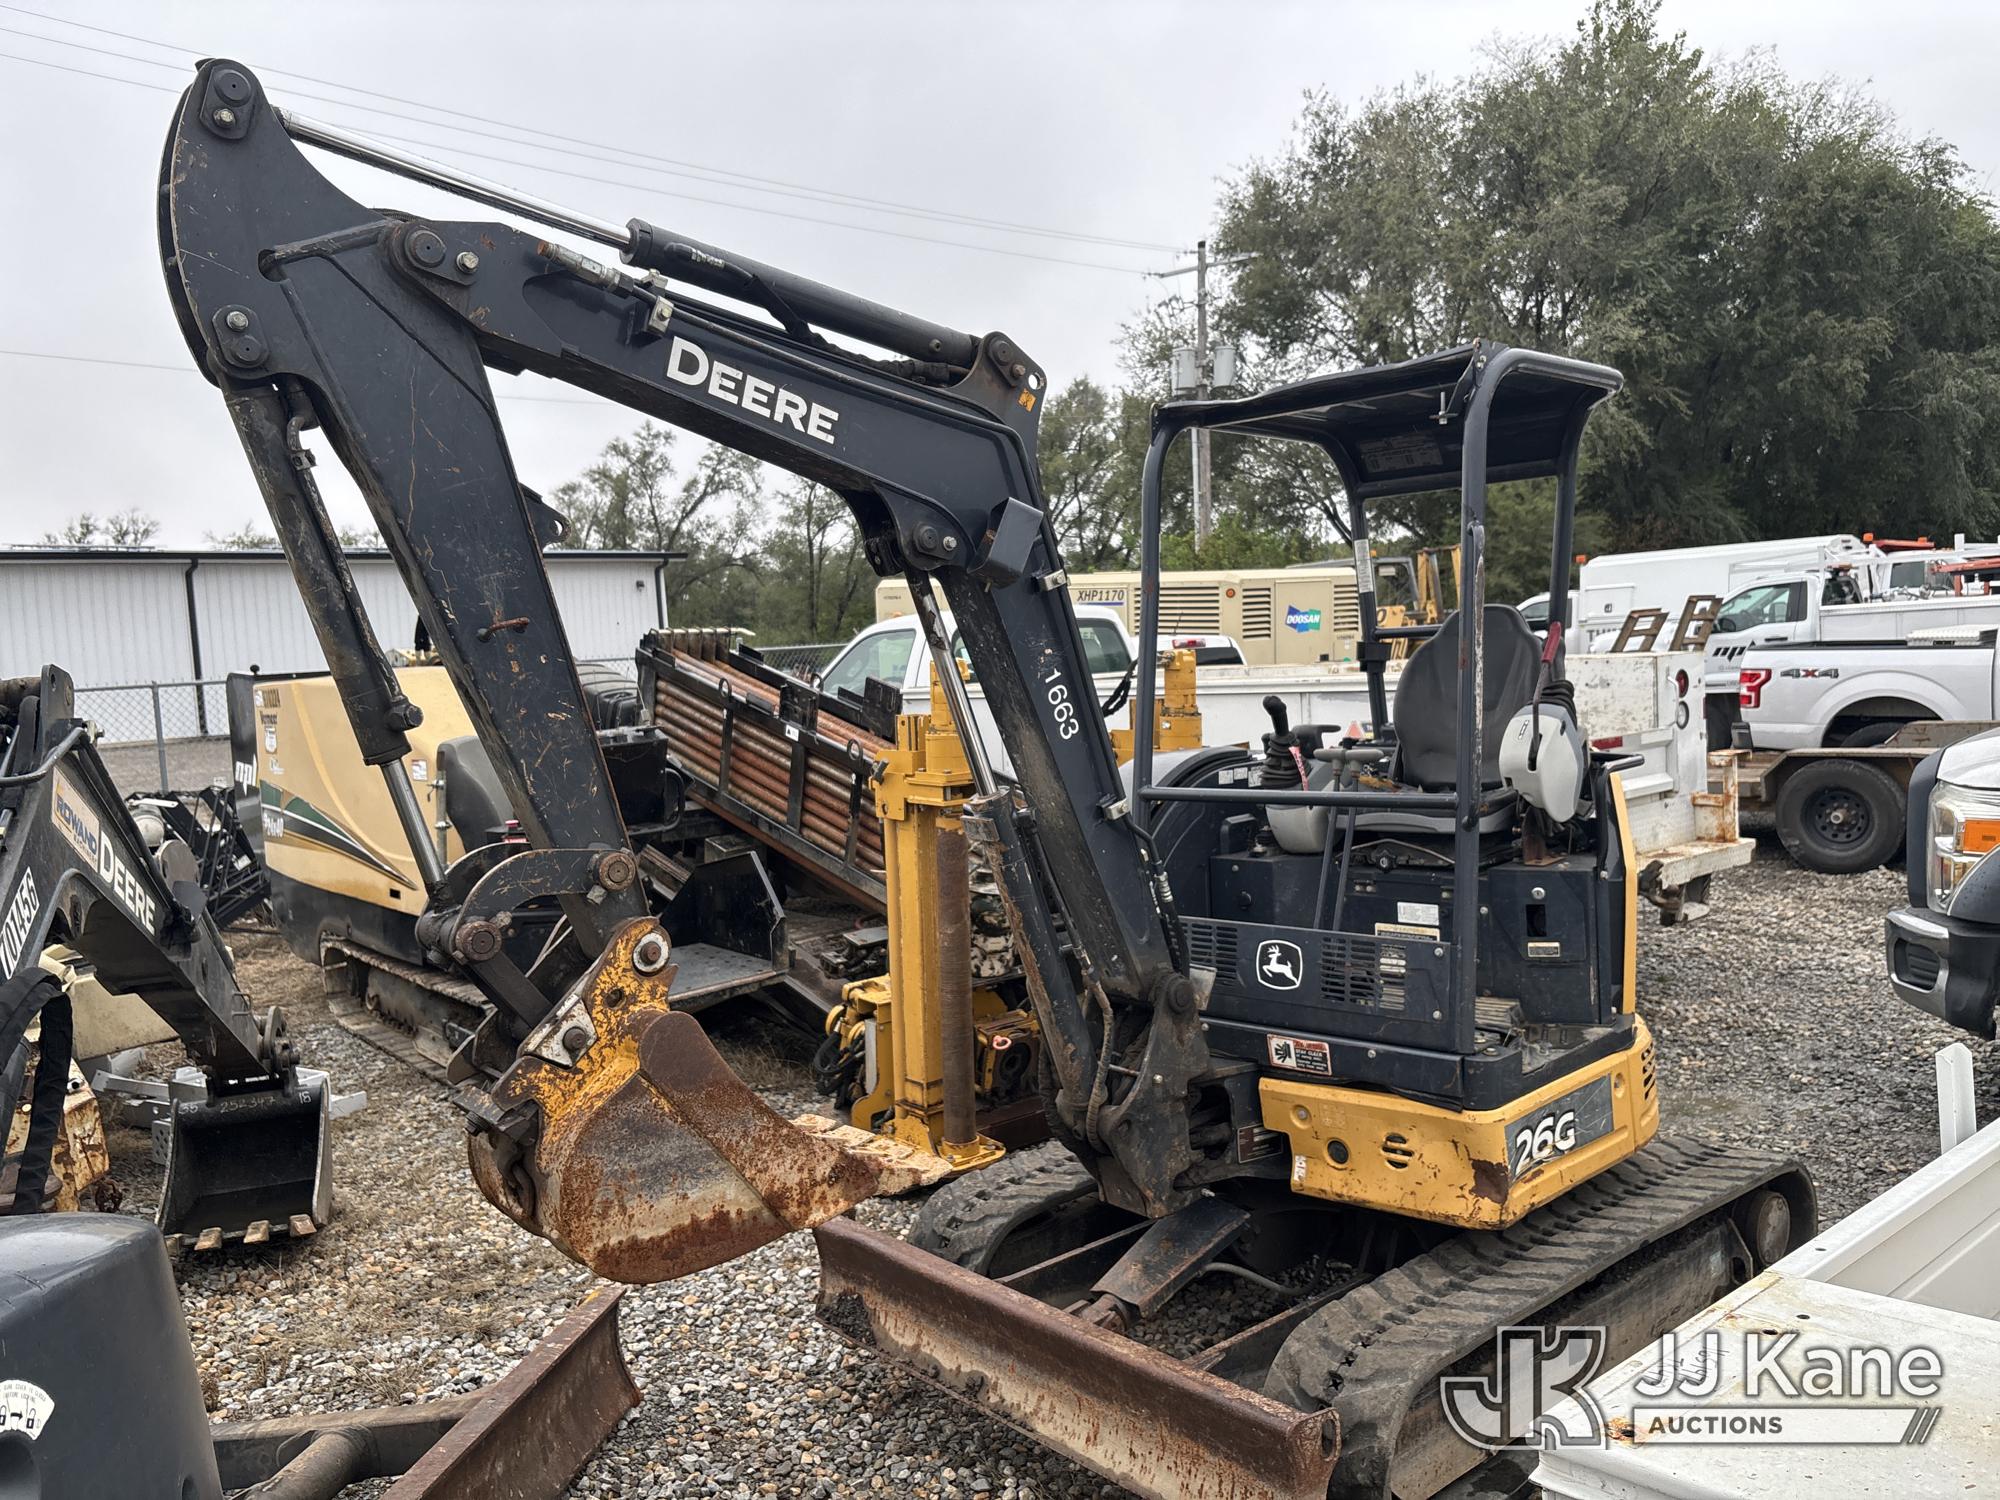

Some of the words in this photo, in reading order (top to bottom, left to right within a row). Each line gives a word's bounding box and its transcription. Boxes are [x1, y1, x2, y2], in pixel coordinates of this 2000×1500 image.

[667, 336, 839, 444] DEERE
[1077, 590, 1125, 602] XHP1170
[1286, 614, 1320, 625] DOOSAN
[1045, 667, 1079, 740] 1663
[55, 796, 98, 856] ROWAND
[100, 830, 156, 936] DEERE
[1515, 1111, 1577, 1176] 26G
